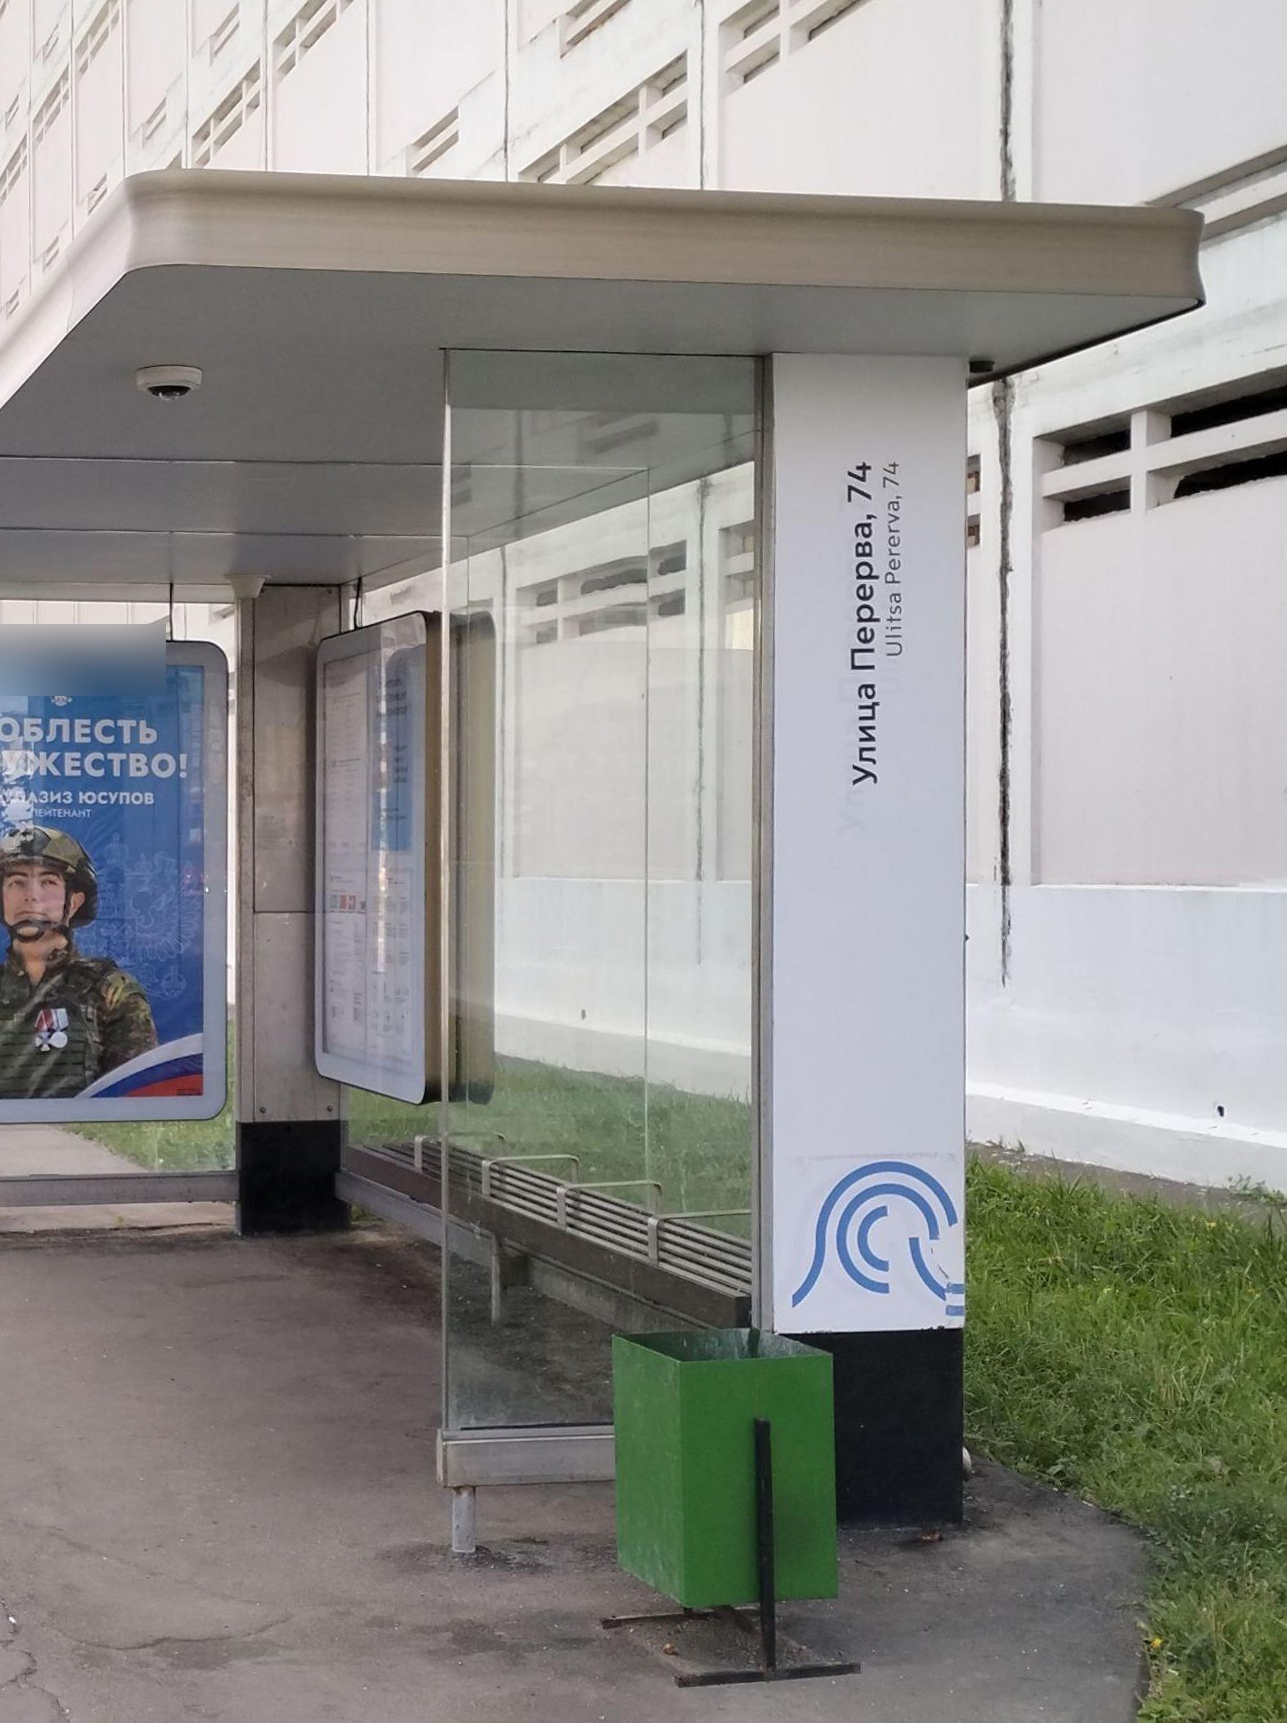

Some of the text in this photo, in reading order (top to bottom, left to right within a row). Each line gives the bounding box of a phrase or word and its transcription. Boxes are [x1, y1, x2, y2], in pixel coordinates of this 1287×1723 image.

[847, 461, 881, 786] Улица Перерва, 74
[882, 461, 903, 657] Ulitsa Pererva, 74
[79, 791, 155, 806] ЮСУПОВ
